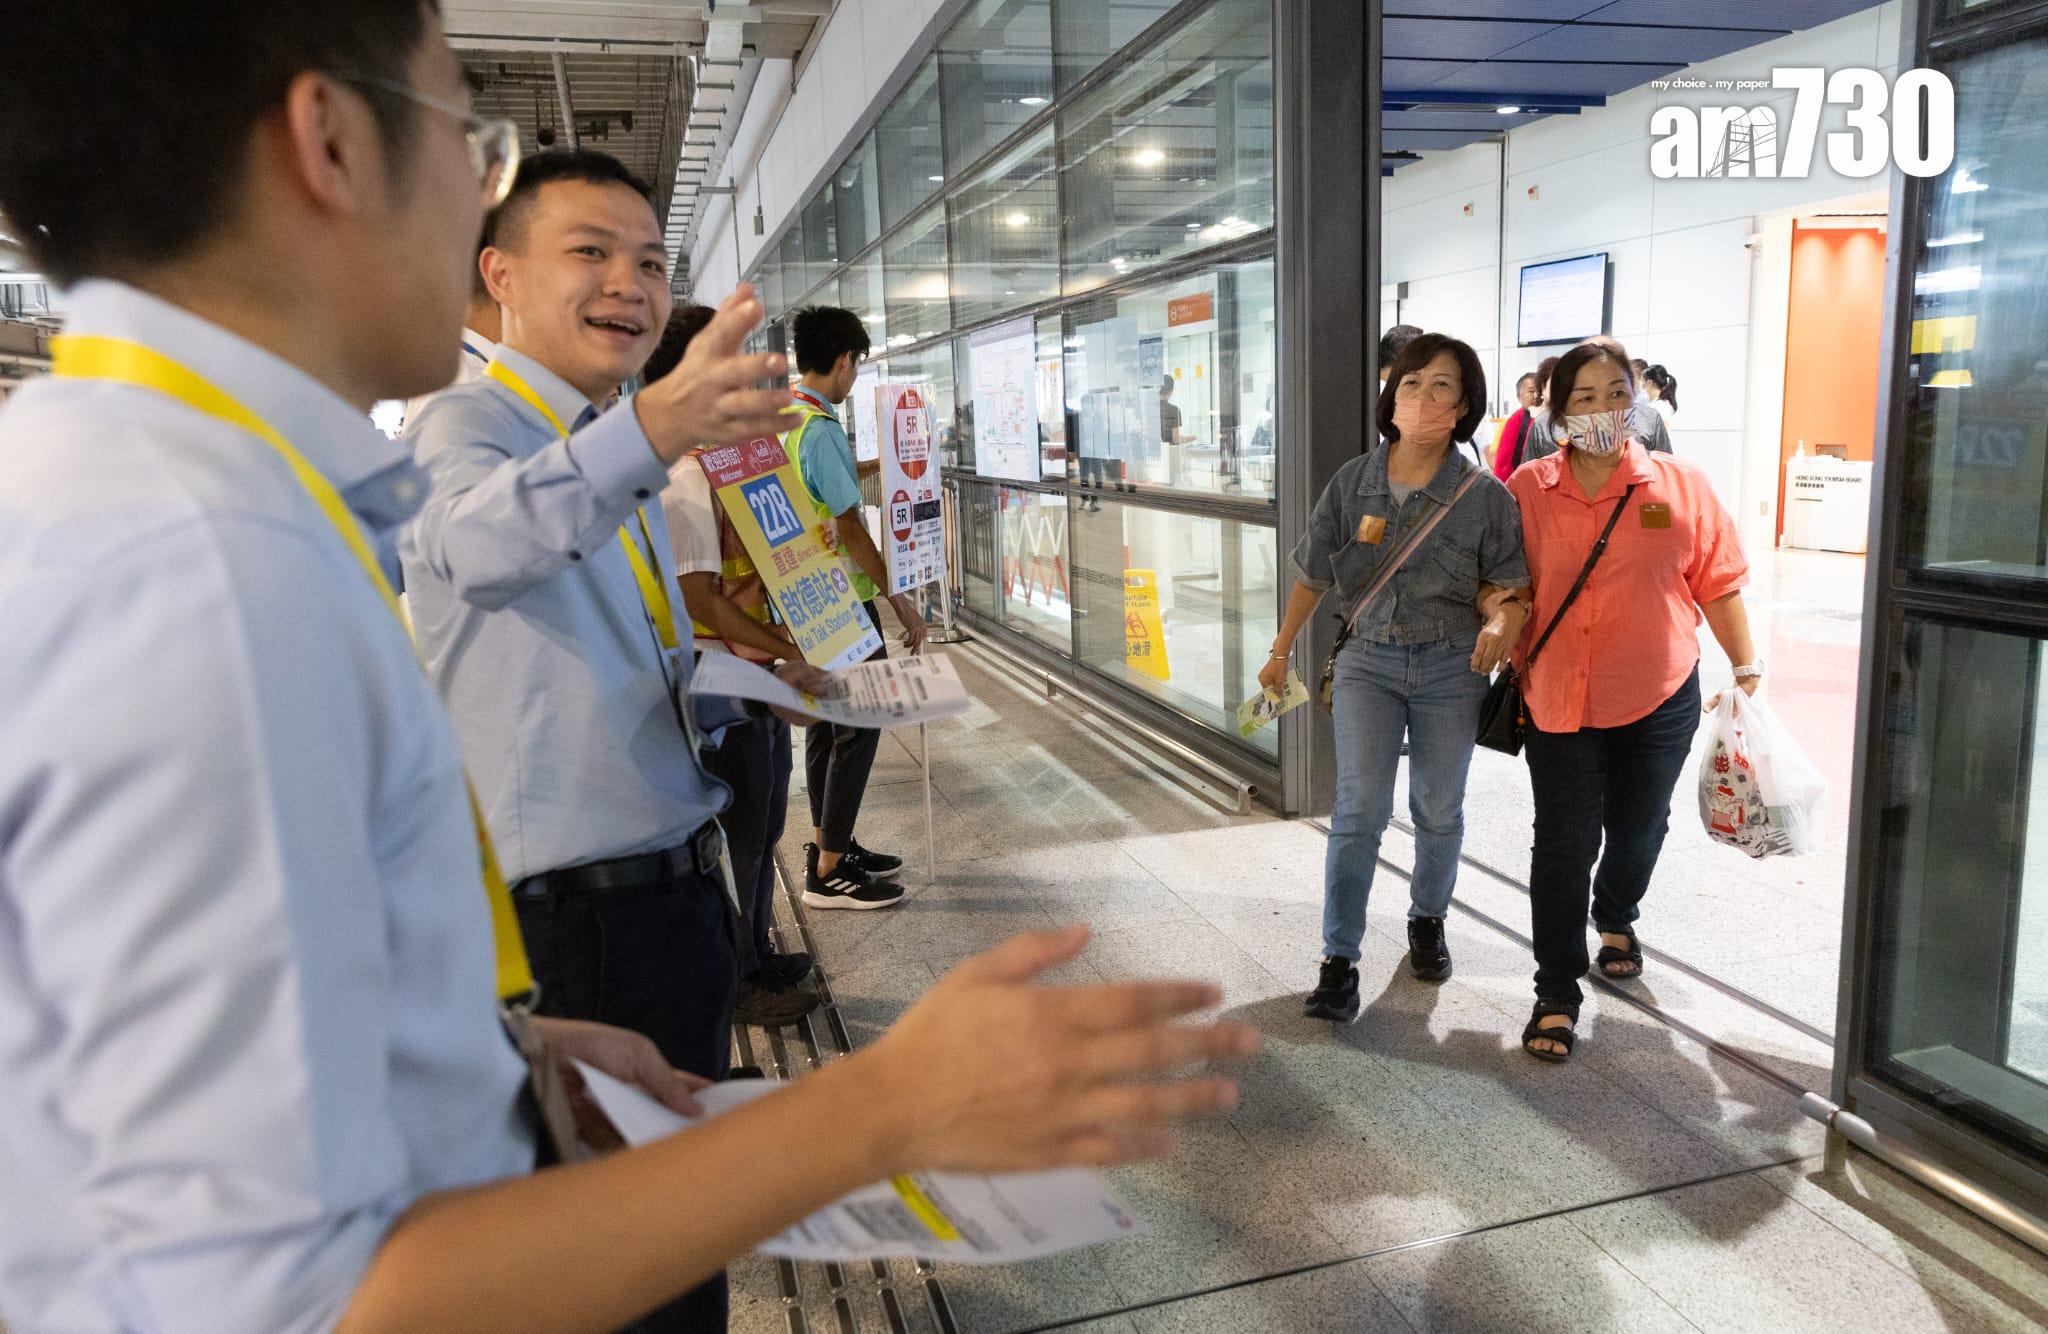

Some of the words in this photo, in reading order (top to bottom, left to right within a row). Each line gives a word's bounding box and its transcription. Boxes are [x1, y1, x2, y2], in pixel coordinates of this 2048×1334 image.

[906, 415, 918, 434] 5R
[748, 483, 801, 541] 22R
[896, 508, 908, 524] 5R
[897, 543, 908, 554] VISA
[797, 632, 815, 653] Kai
[810, 621, 829, 642] Tak
[825, 610, 854, 635] Station
